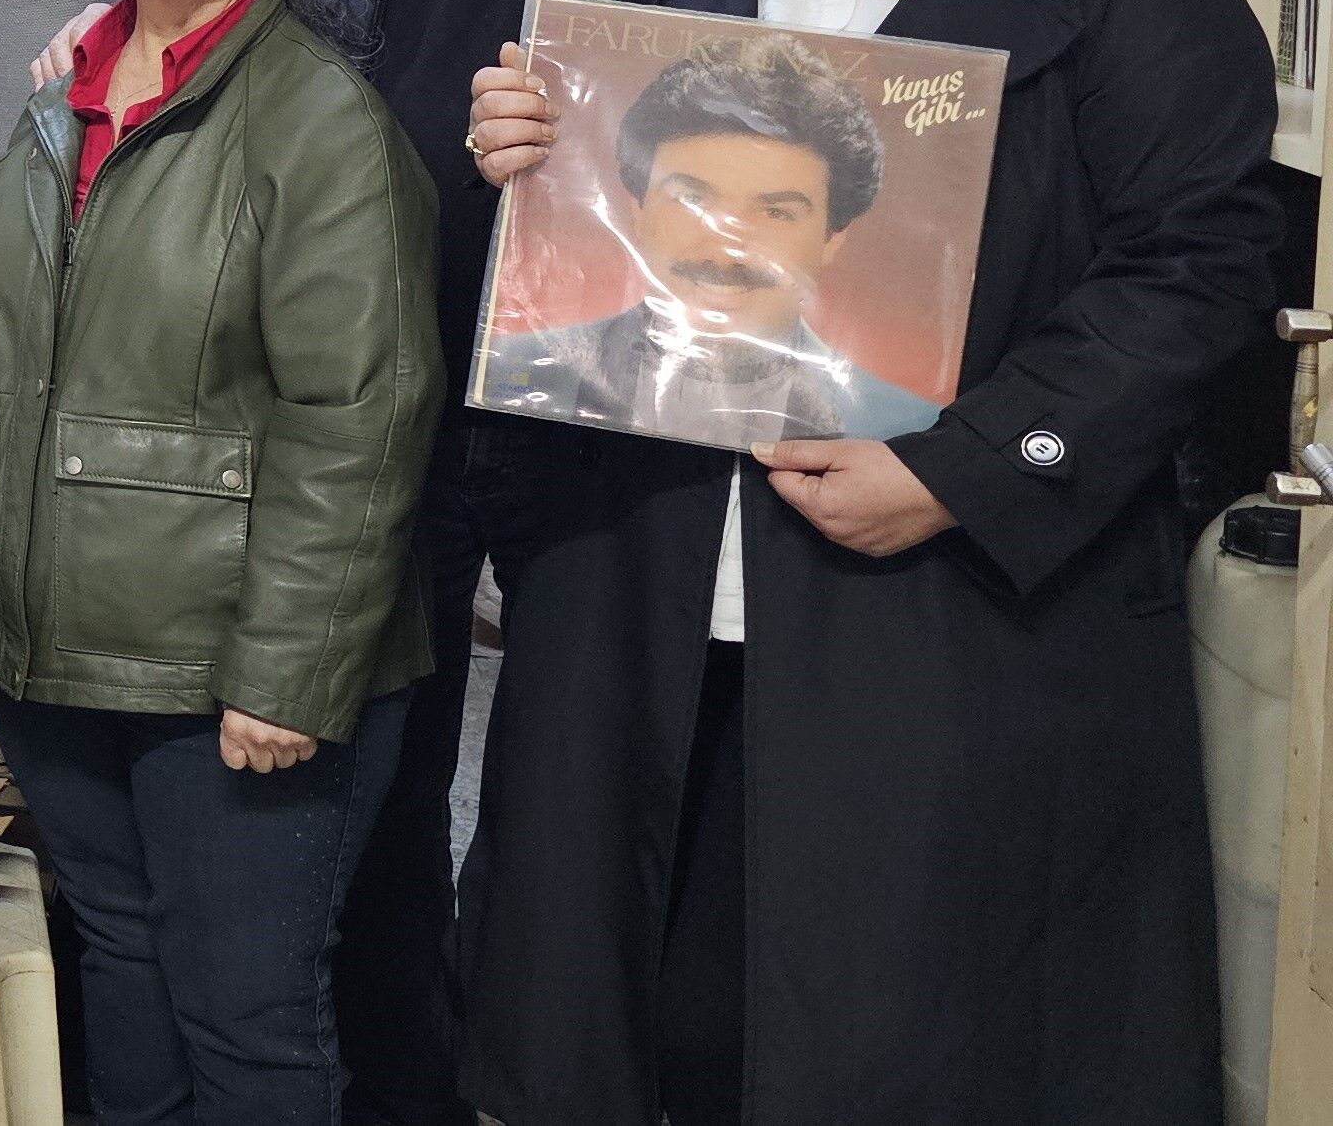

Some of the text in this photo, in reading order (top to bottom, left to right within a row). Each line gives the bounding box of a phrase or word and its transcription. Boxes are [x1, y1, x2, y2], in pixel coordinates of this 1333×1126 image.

[565, 13, 710, 63] FARUK
[881, 70, 964, 107] Yunus
[905, 94, 964, 136] Gibi
